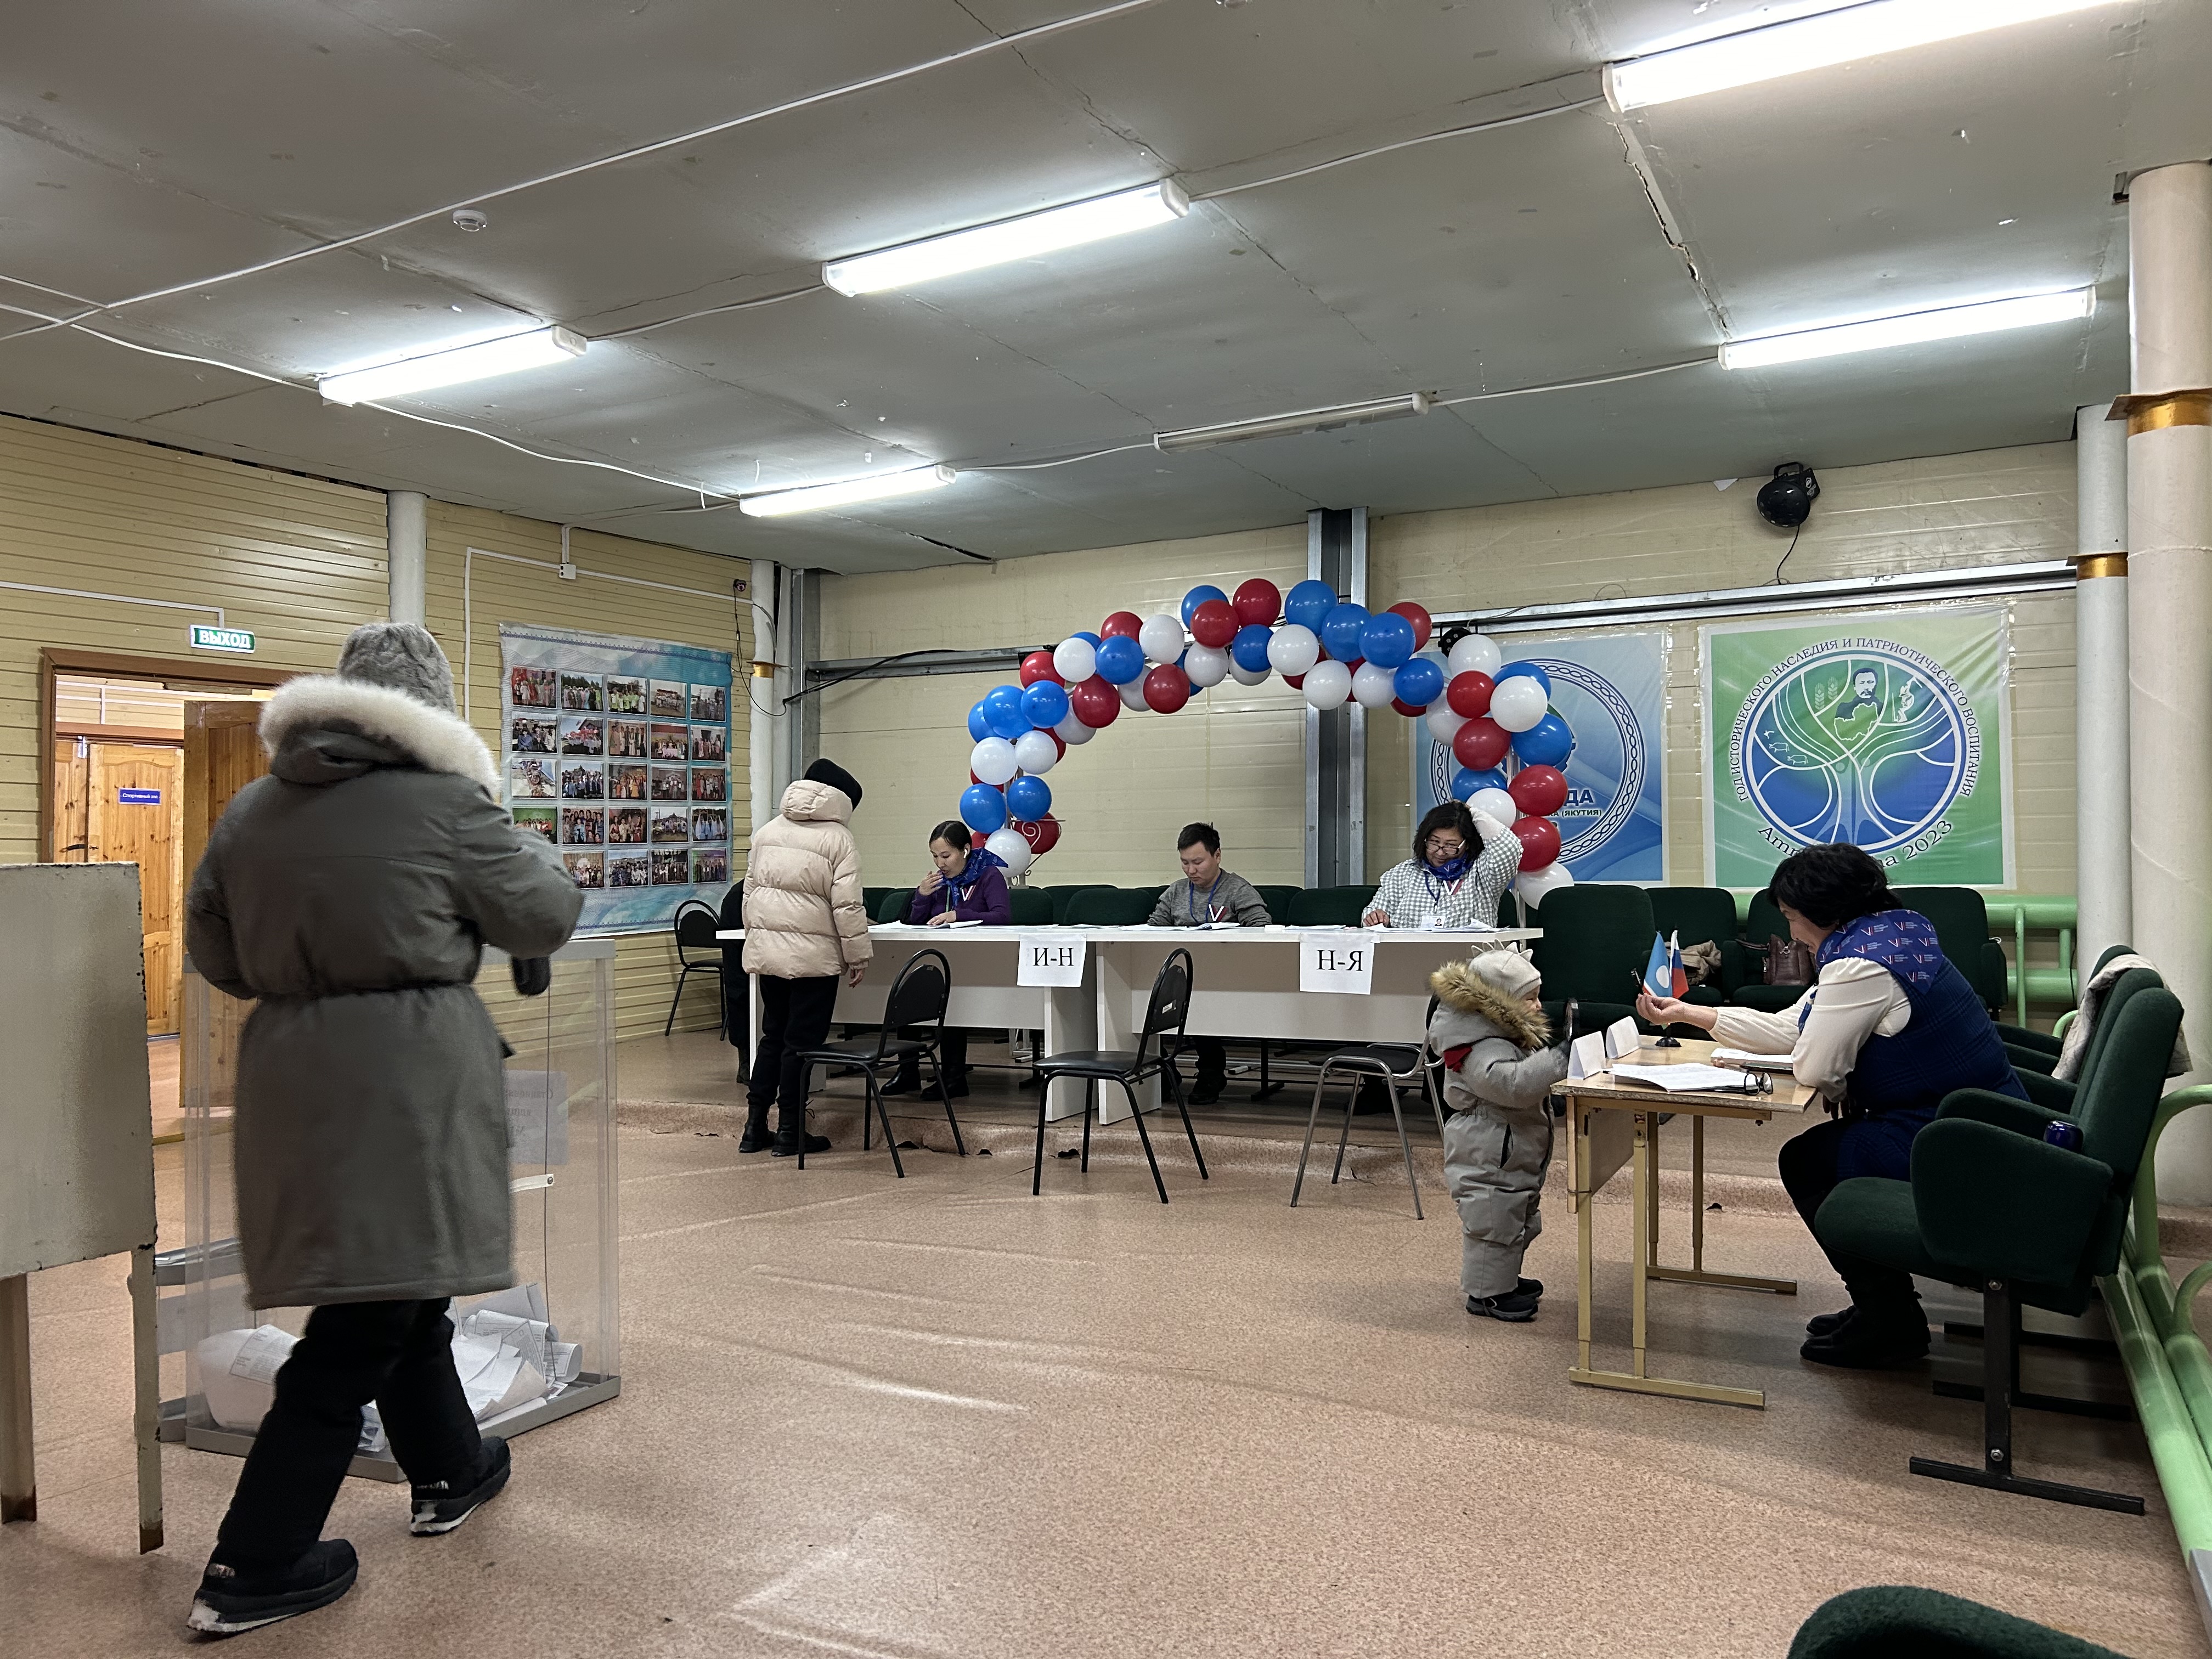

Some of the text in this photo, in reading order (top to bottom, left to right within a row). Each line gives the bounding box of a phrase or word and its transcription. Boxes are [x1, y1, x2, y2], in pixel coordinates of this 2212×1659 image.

[199, 630, 251, 648] ВЫХОД
[1730, 637, 1980, 802] ГОД ИСТОРИЧЕСКОГО НАСЛЕДИЯ И ПАТРИОТИЧЕСКОГО ВОСПИТАНИЯ
[1562, 809, 1602, 817] (ЯКУТИЯ)
[1902, 820, 1952, 860] 2023
[1032, 947, 1074, 966] И-Н
[1316, 949, 1364, 972] Н-Я
